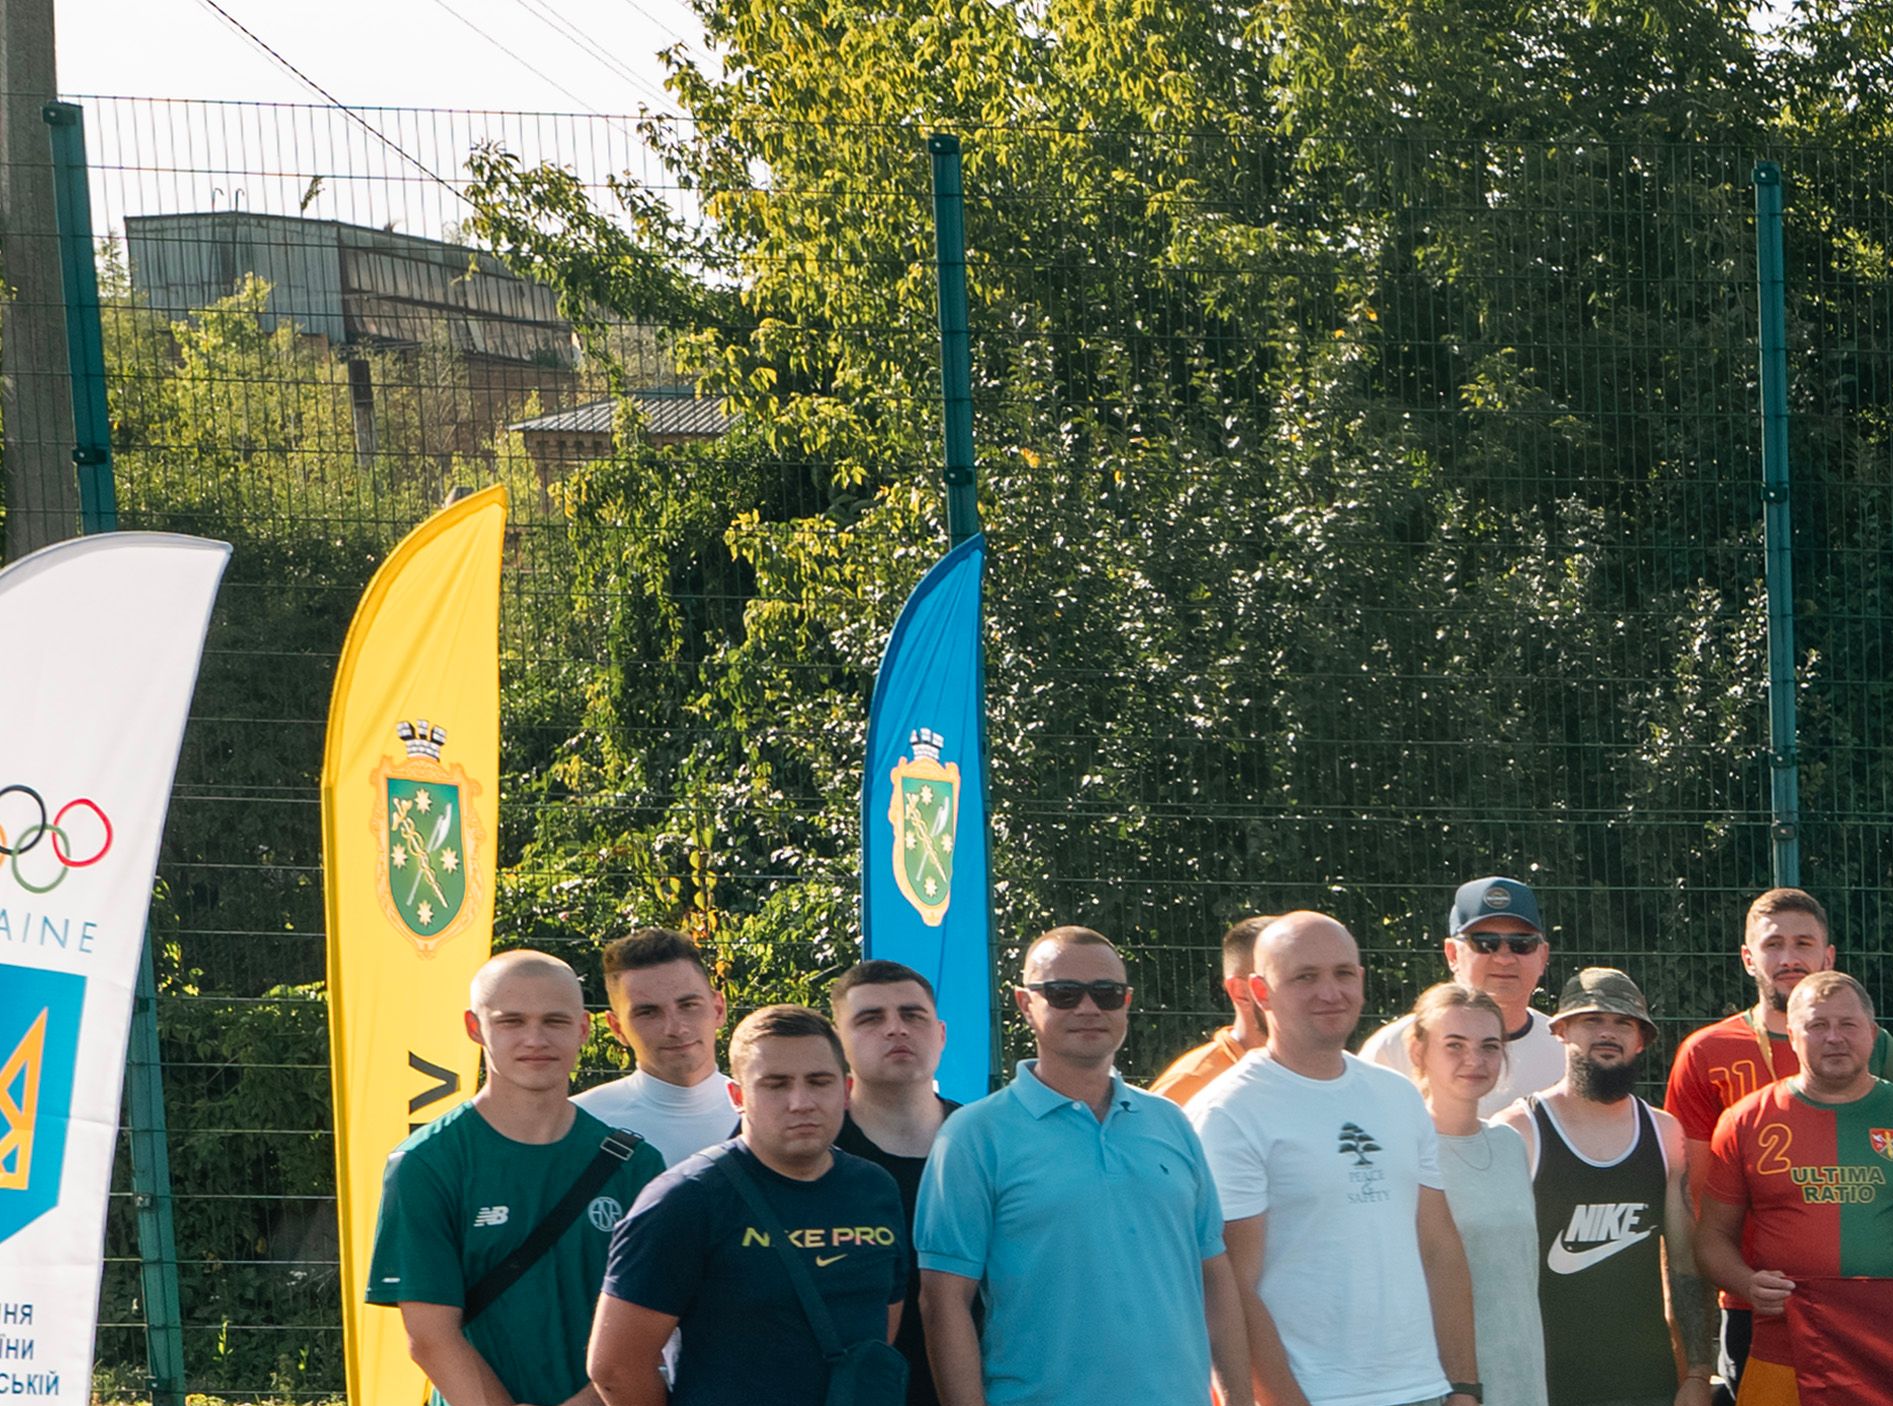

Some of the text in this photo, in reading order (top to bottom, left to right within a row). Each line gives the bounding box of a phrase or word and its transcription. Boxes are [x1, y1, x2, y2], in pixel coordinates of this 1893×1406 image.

[1757, 1123, 1793, 1175] 2
[1791, 1167, 1885, 1184] ULTIMA
[1803, 1185, 1876, 1203] RATIO
[1564, 1203, 1645, 1242] NIKE
[741, 1226, 895, 1248] NKE PRO
